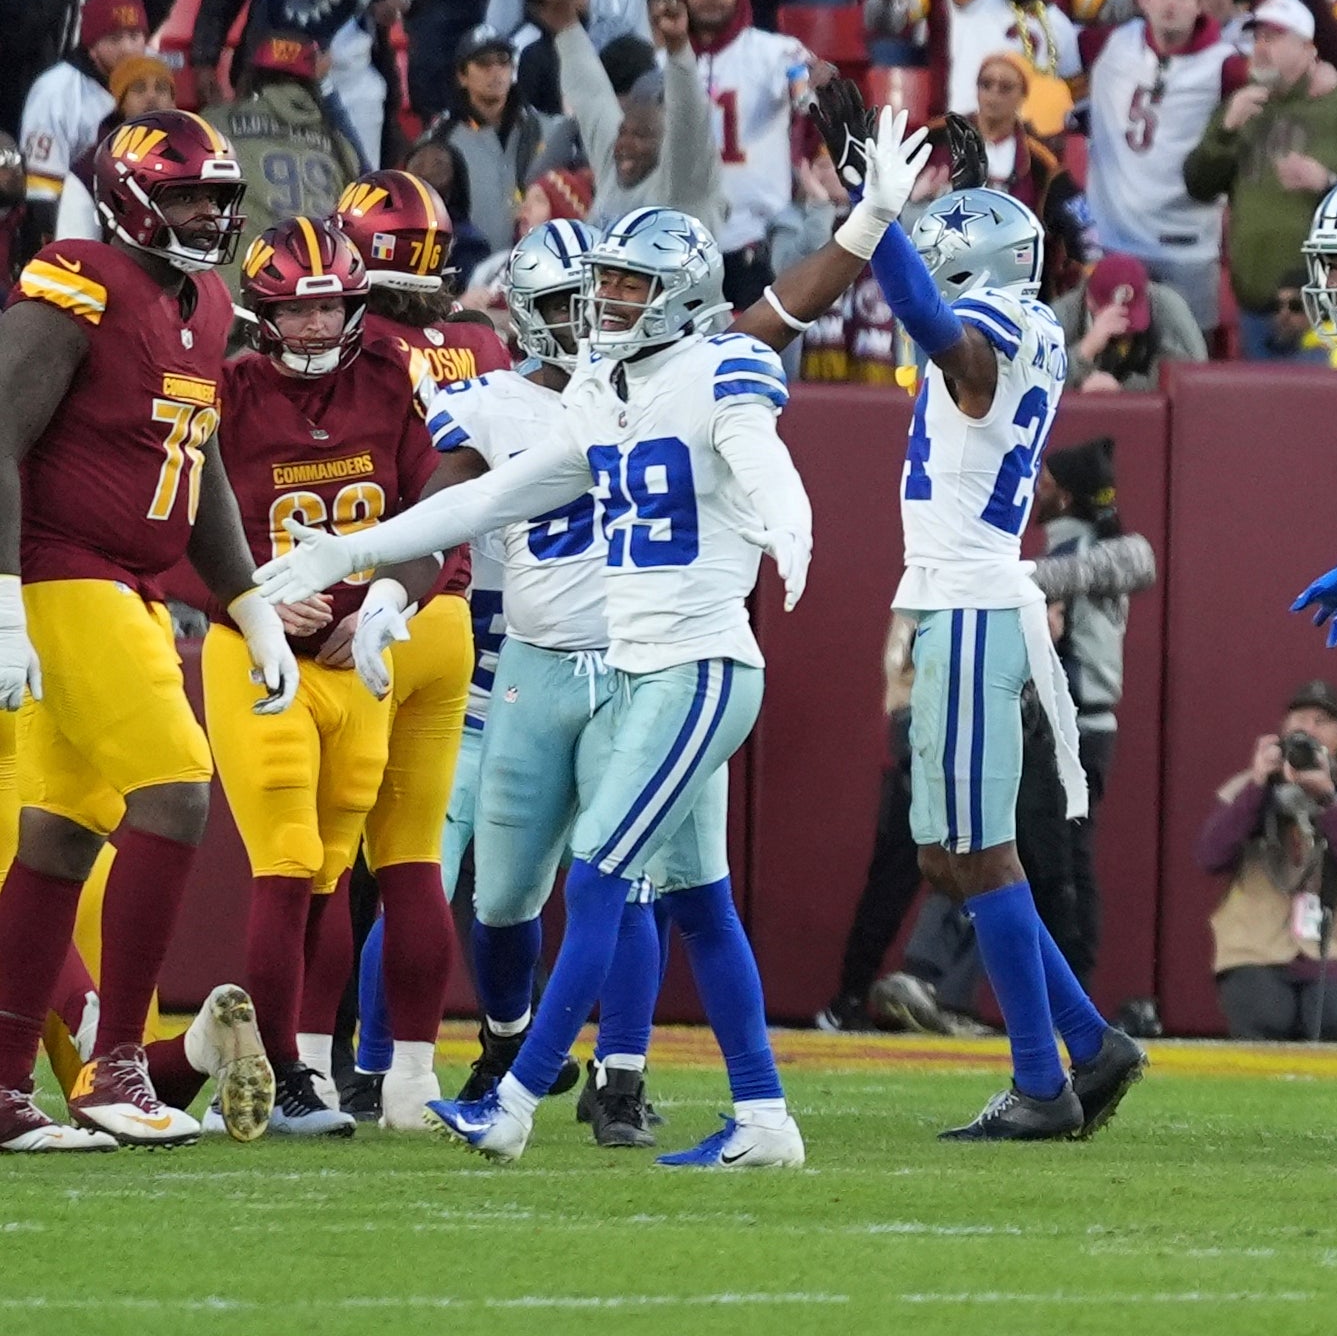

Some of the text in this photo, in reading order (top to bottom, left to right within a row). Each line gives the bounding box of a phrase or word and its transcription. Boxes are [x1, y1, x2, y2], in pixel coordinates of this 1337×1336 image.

[717, 90, 747, 164] 1
[1126, 84, 1164, 154] 5
[412, 347, 477, 382] OSMI
[273, 456, 375, 486] COMMANDERS
